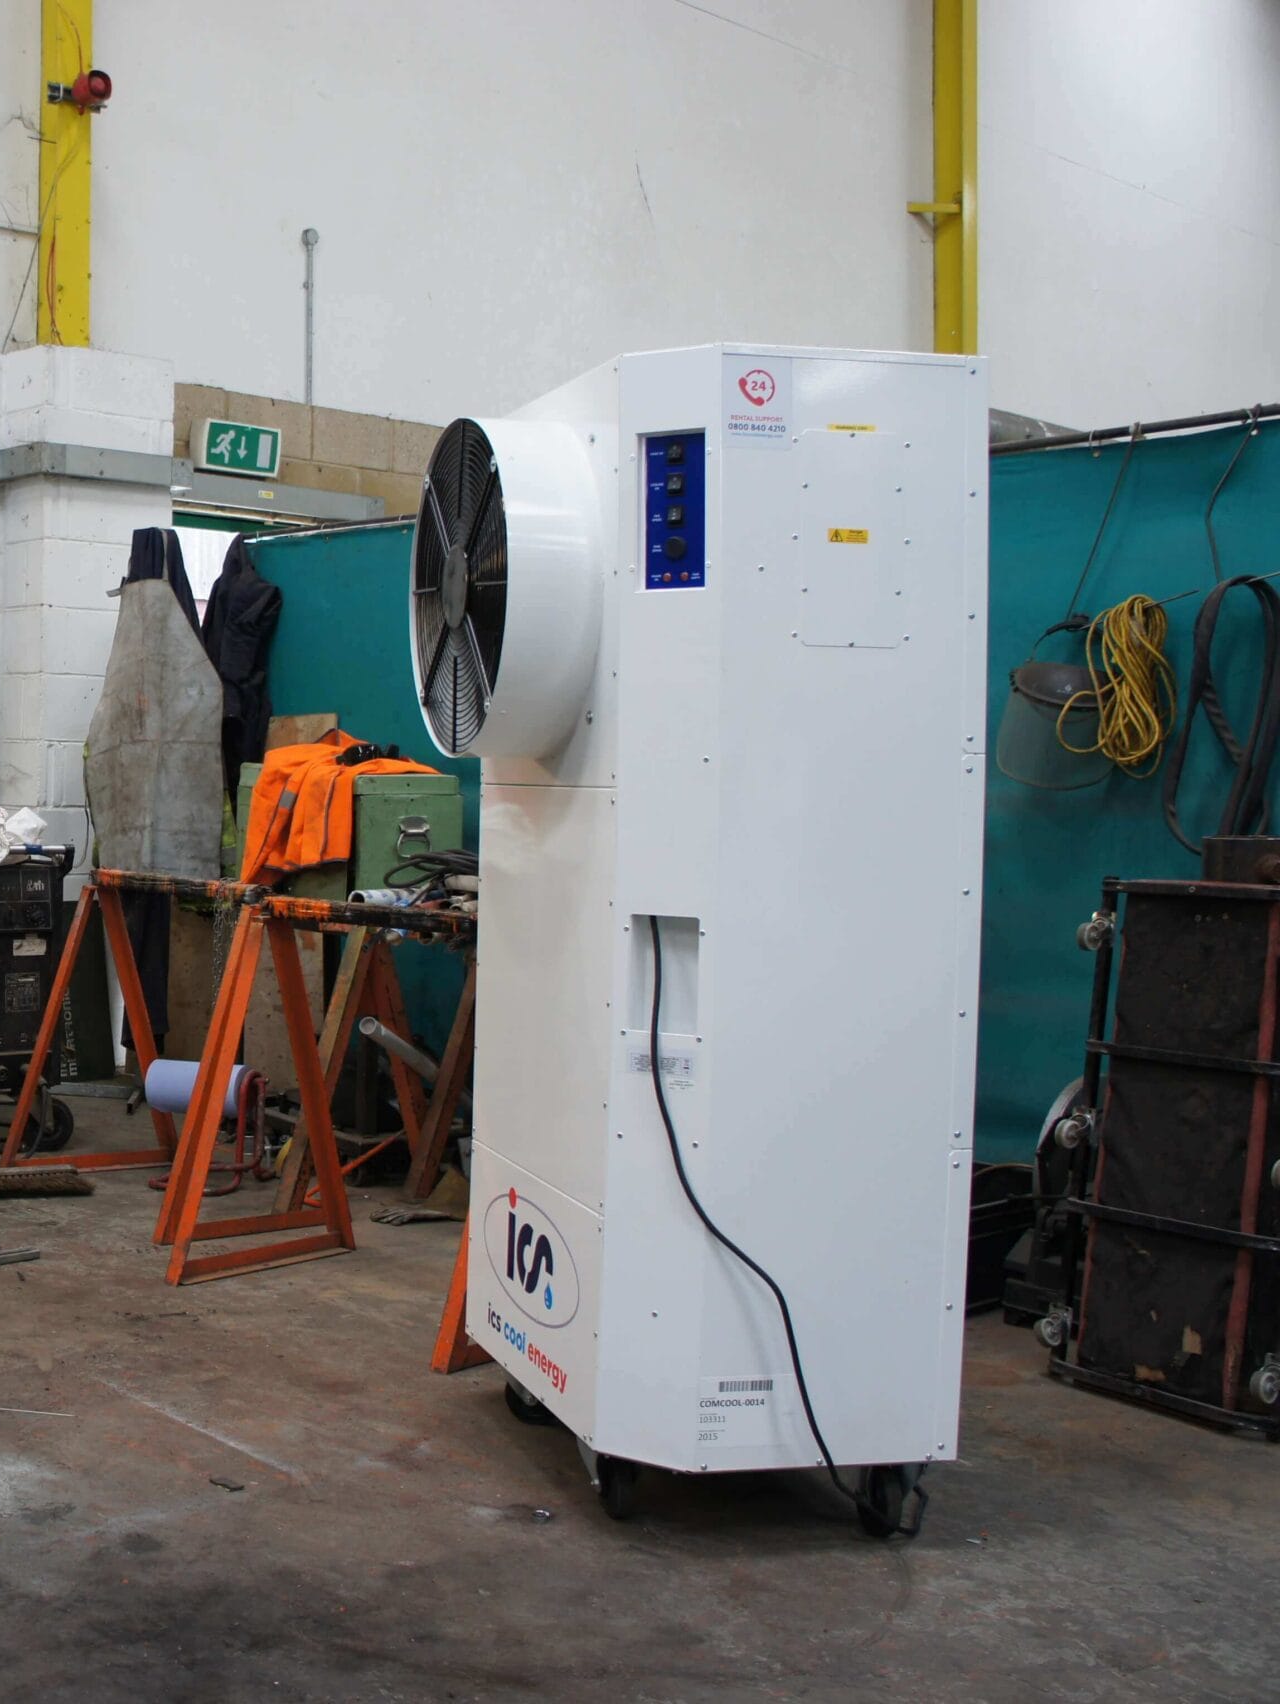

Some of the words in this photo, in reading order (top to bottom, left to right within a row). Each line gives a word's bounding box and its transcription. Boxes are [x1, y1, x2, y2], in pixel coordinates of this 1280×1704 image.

[751, 380, 767, 391] 24
[730, 414, 753, 422] RENTAL
[728, 423, 749, 431] 0800
[751, 424, 766, 432] 840
[768, 425, 786, 433] 4210
[487, 1303, 502, 1332] ics
[503, 1322, 526, 1354] cool
[527, 1343, 568, 1393] energy
[699, 1399, 765, 1408] COMCOOL-0014
[699, 1415, 726, 1424] 103311
[698, 1432, 719, 1441] 2015
